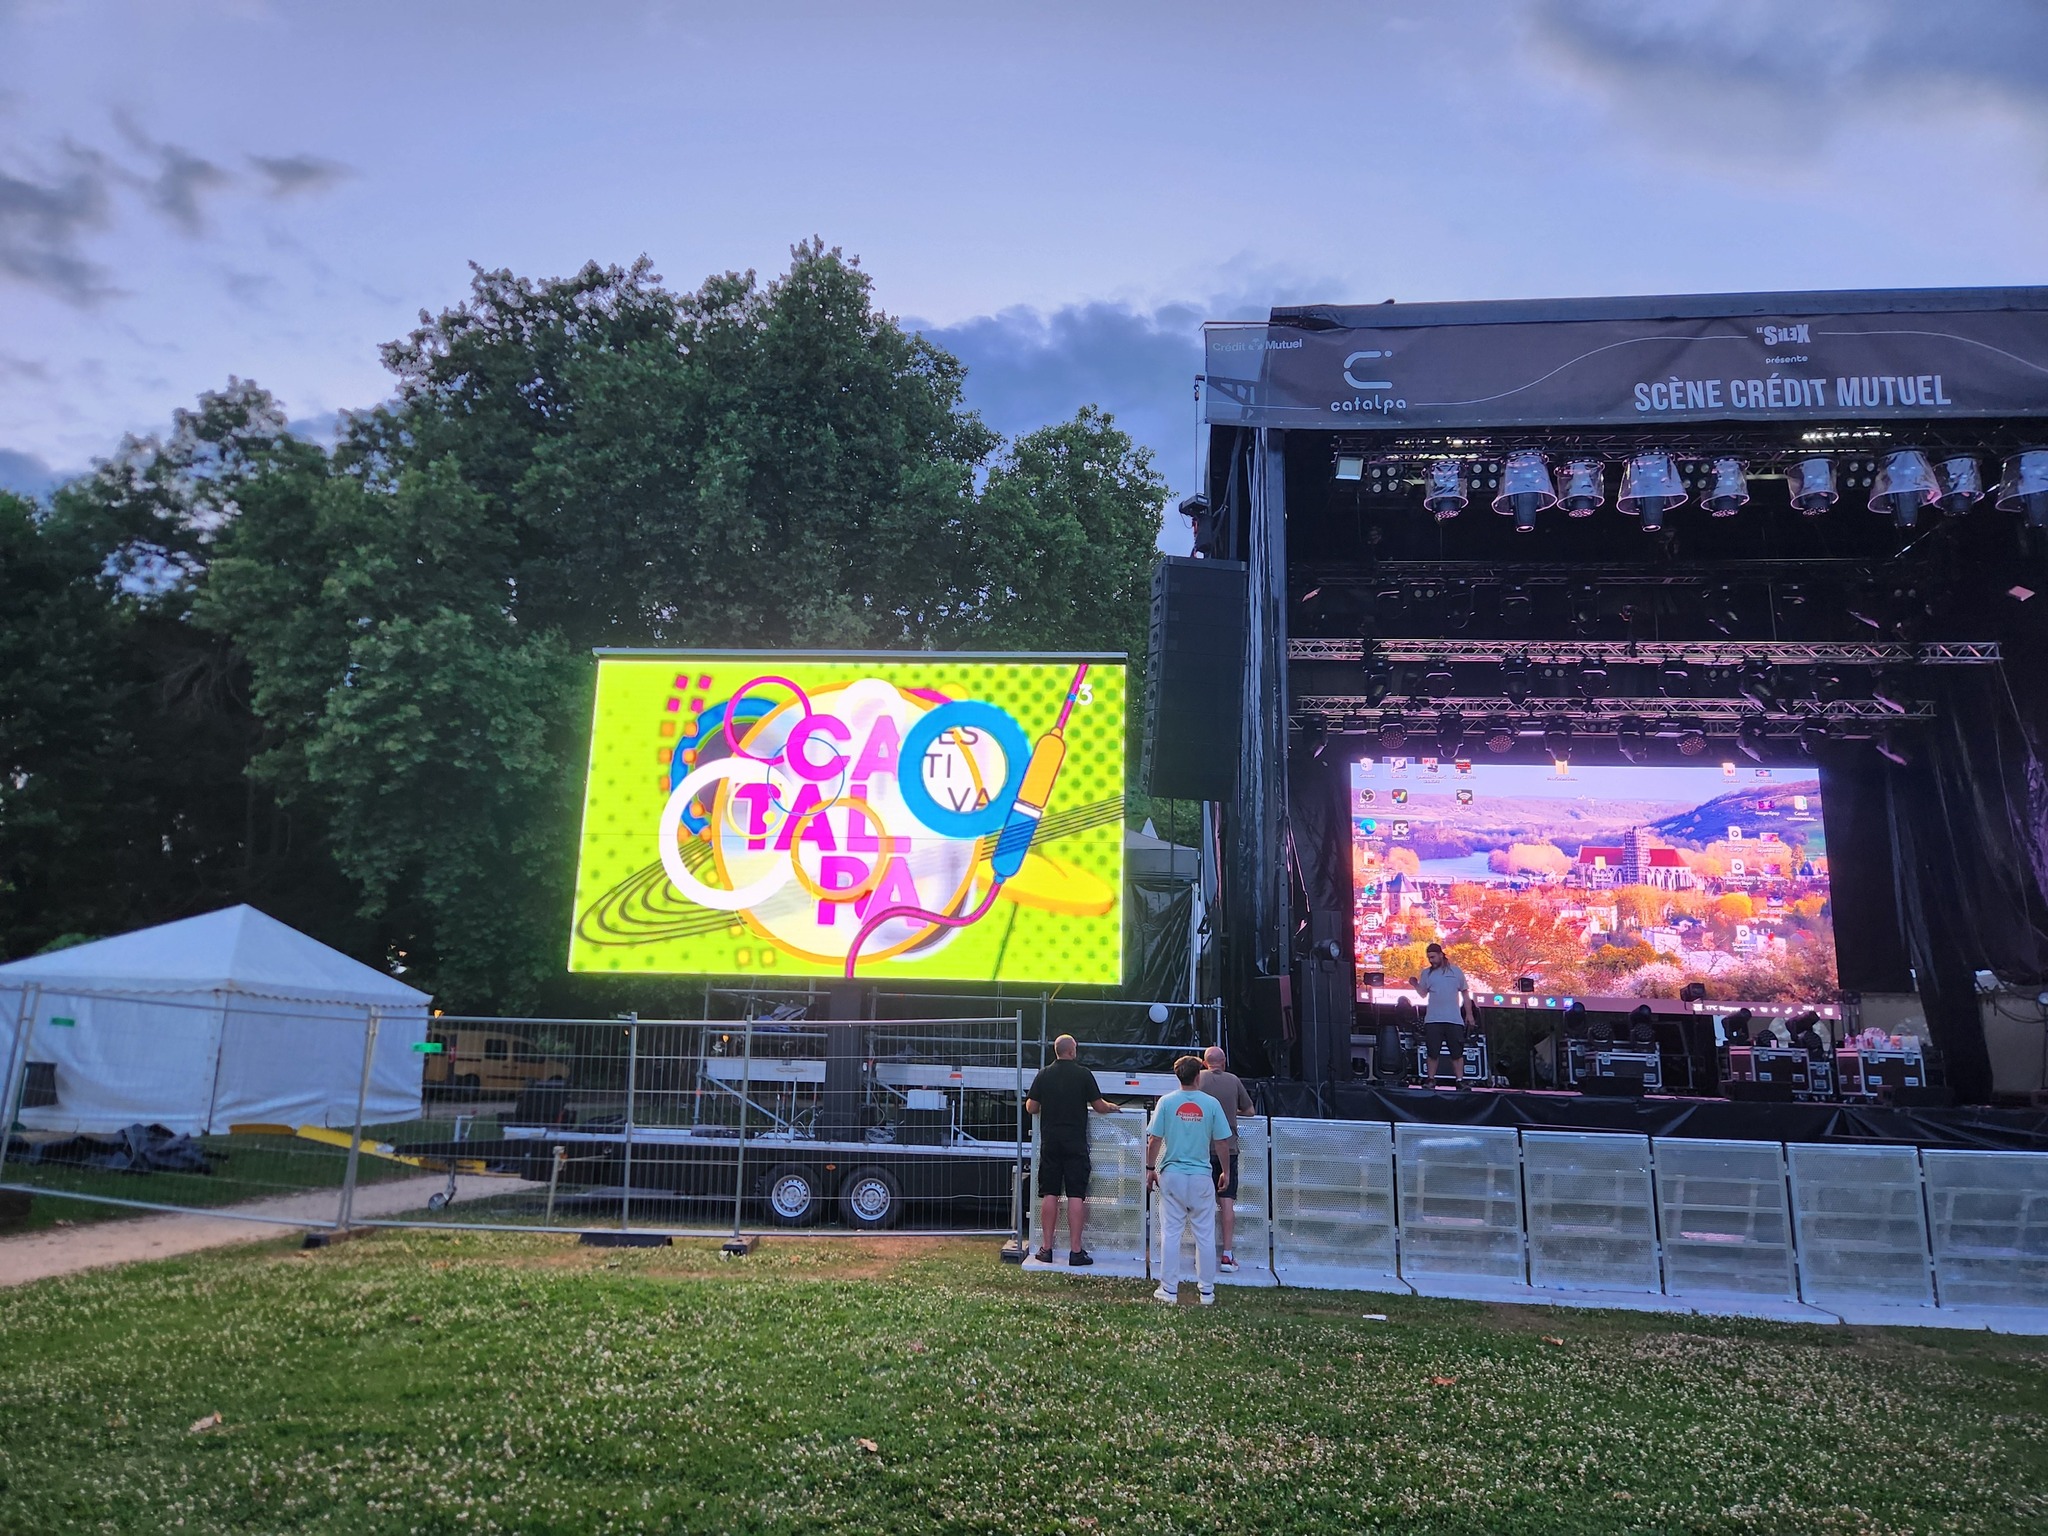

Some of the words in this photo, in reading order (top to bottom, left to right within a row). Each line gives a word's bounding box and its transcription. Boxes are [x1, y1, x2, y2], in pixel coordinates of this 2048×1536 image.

[1212, 342, 1246, 352] Crédit
[1265, 338, 1303, 350] Mutuel
[1765, 355, 1808, 365] présente
[1634, 375, 1724, 412] SCÈNE
[1730, 372, 1826, 409] CRÉDIT
[1836, 374, 1952, 407] MUTUEL
[1330, 395, 1407, 415] catalpa
[734, 782, 912, 853] TAL
